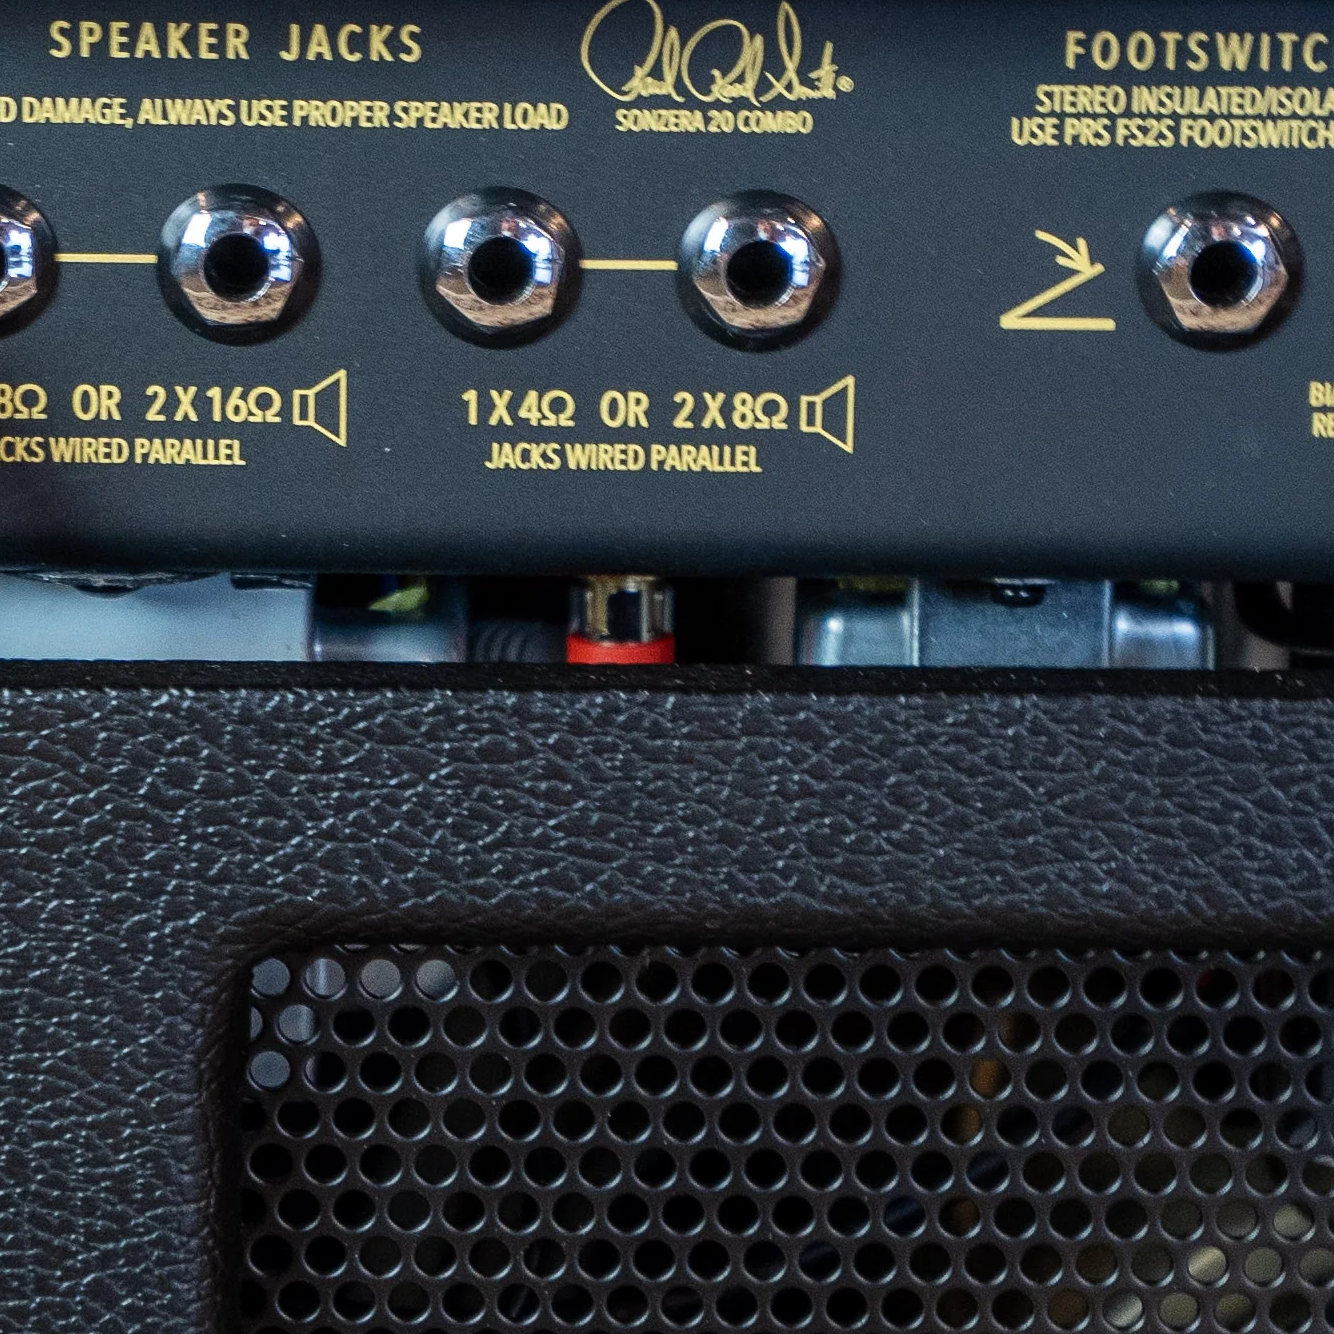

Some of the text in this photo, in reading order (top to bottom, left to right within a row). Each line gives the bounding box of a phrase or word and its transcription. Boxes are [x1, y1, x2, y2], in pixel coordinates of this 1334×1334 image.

[49, 19, 422, 63] SPEAKER JACKS
[20, 95, 136, 128] DAMAGE,
[136, 97, 236, 127] ALWAYS
[238, 97, 290, 128] USE
[291, 98, 392, 128] PROPER
[393, 99, 500, 129] SPEAKER
[501, 101, 569, 130] LOAD
[1035, 83, 1128, 114] STEREO
[615, 107, 814, 134] SONZERA 20 COMBO
[1010, 115, 1060, 146] USE
[1063, 116, 1112, 147] PRS
[1115, 116, 1176, 147] FS2S
[71, 382, 122, 421] OR
[598, 389, 650, 428] OR
[48, 435, 130, 465] WIRED
[132, 436, 246, 466] PARALLEL
[484, 441, 762, 473] JACKS WIRED PARALLEL
